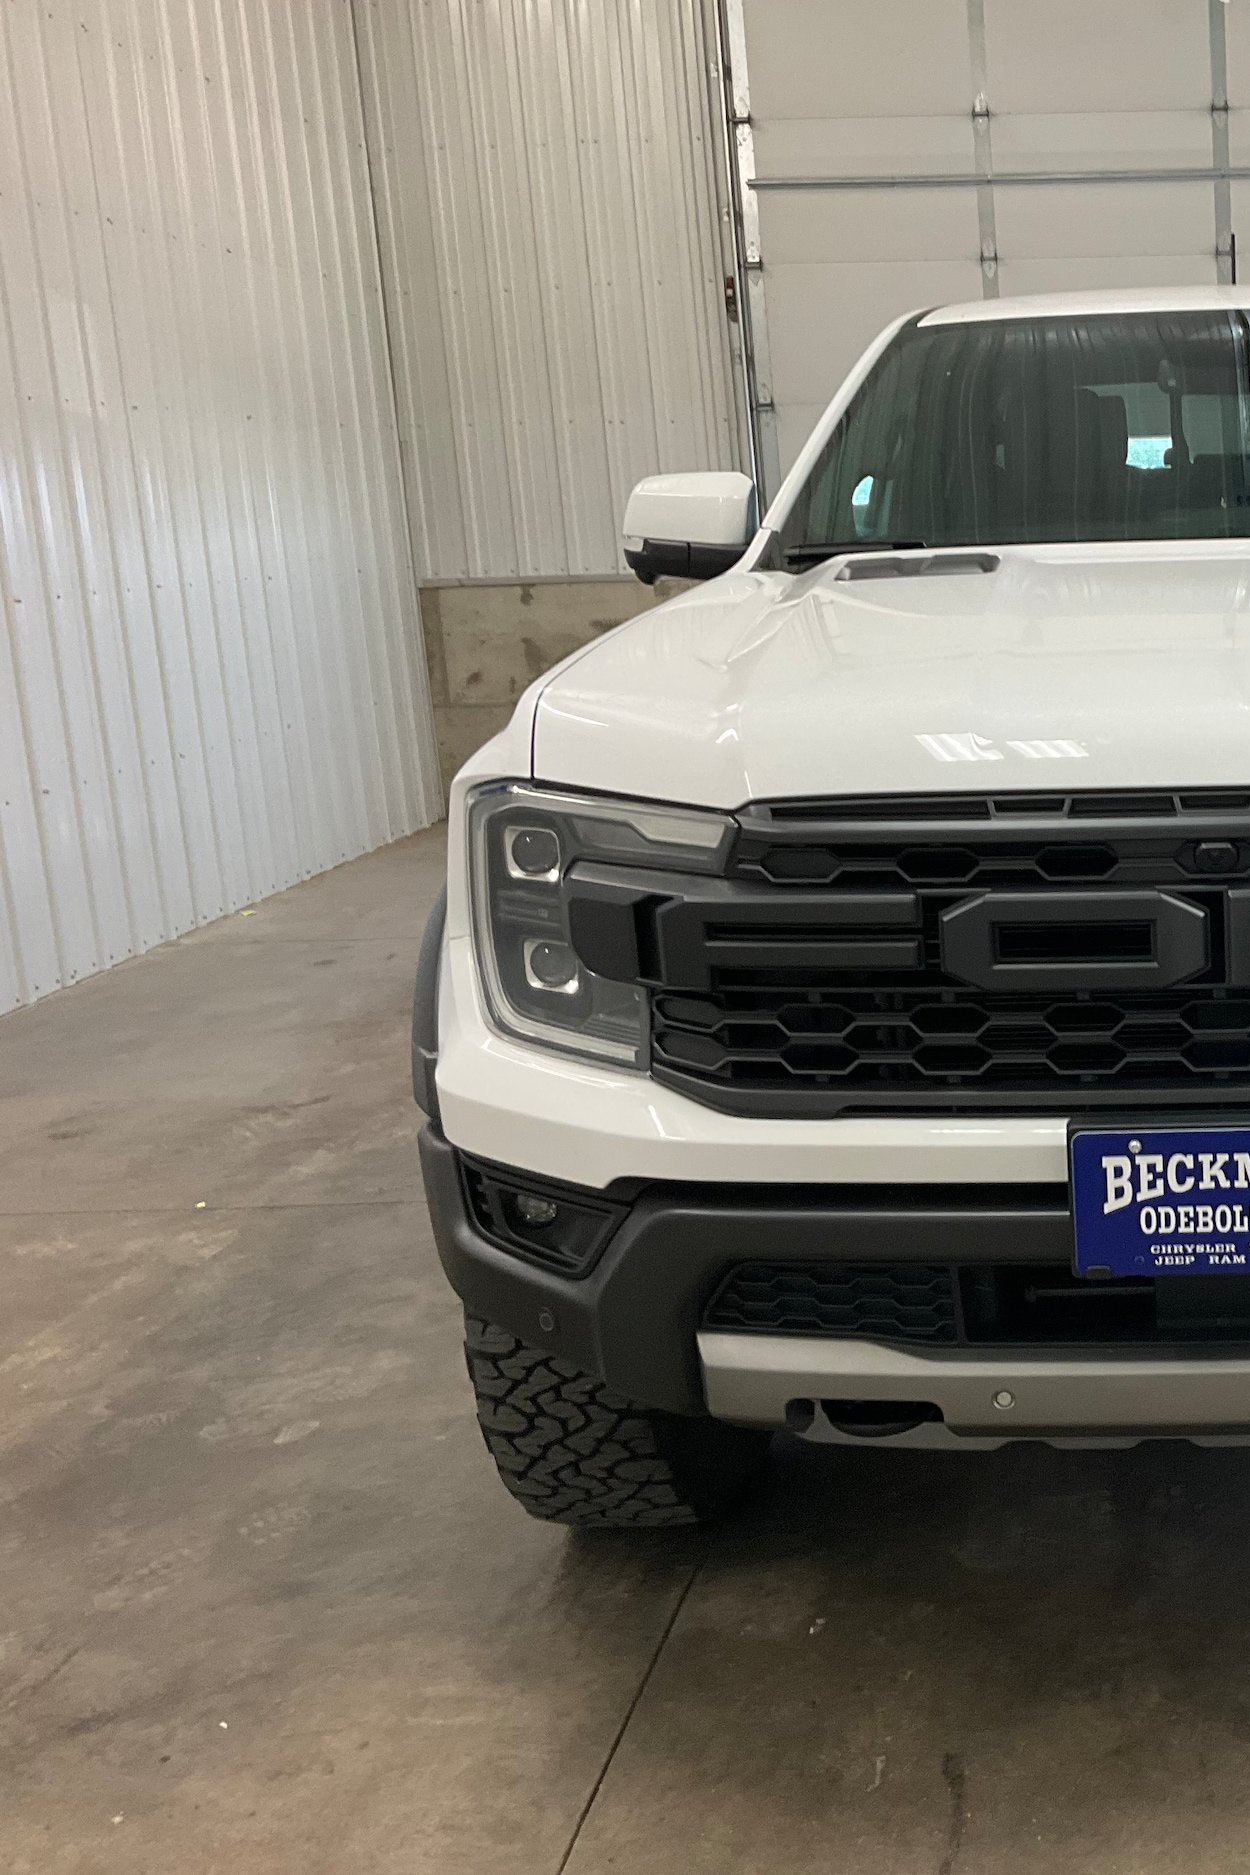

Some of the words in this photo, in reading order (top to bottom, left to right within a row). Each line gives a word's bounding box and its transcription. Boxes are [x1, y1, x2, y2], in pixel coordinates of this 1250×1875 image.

[1150, 1243, 1237, 1254] CHRYSLER
[1154, 1255, 1196, 1266] JEEP
[1208, 1254, 1247, 1264] RAM
